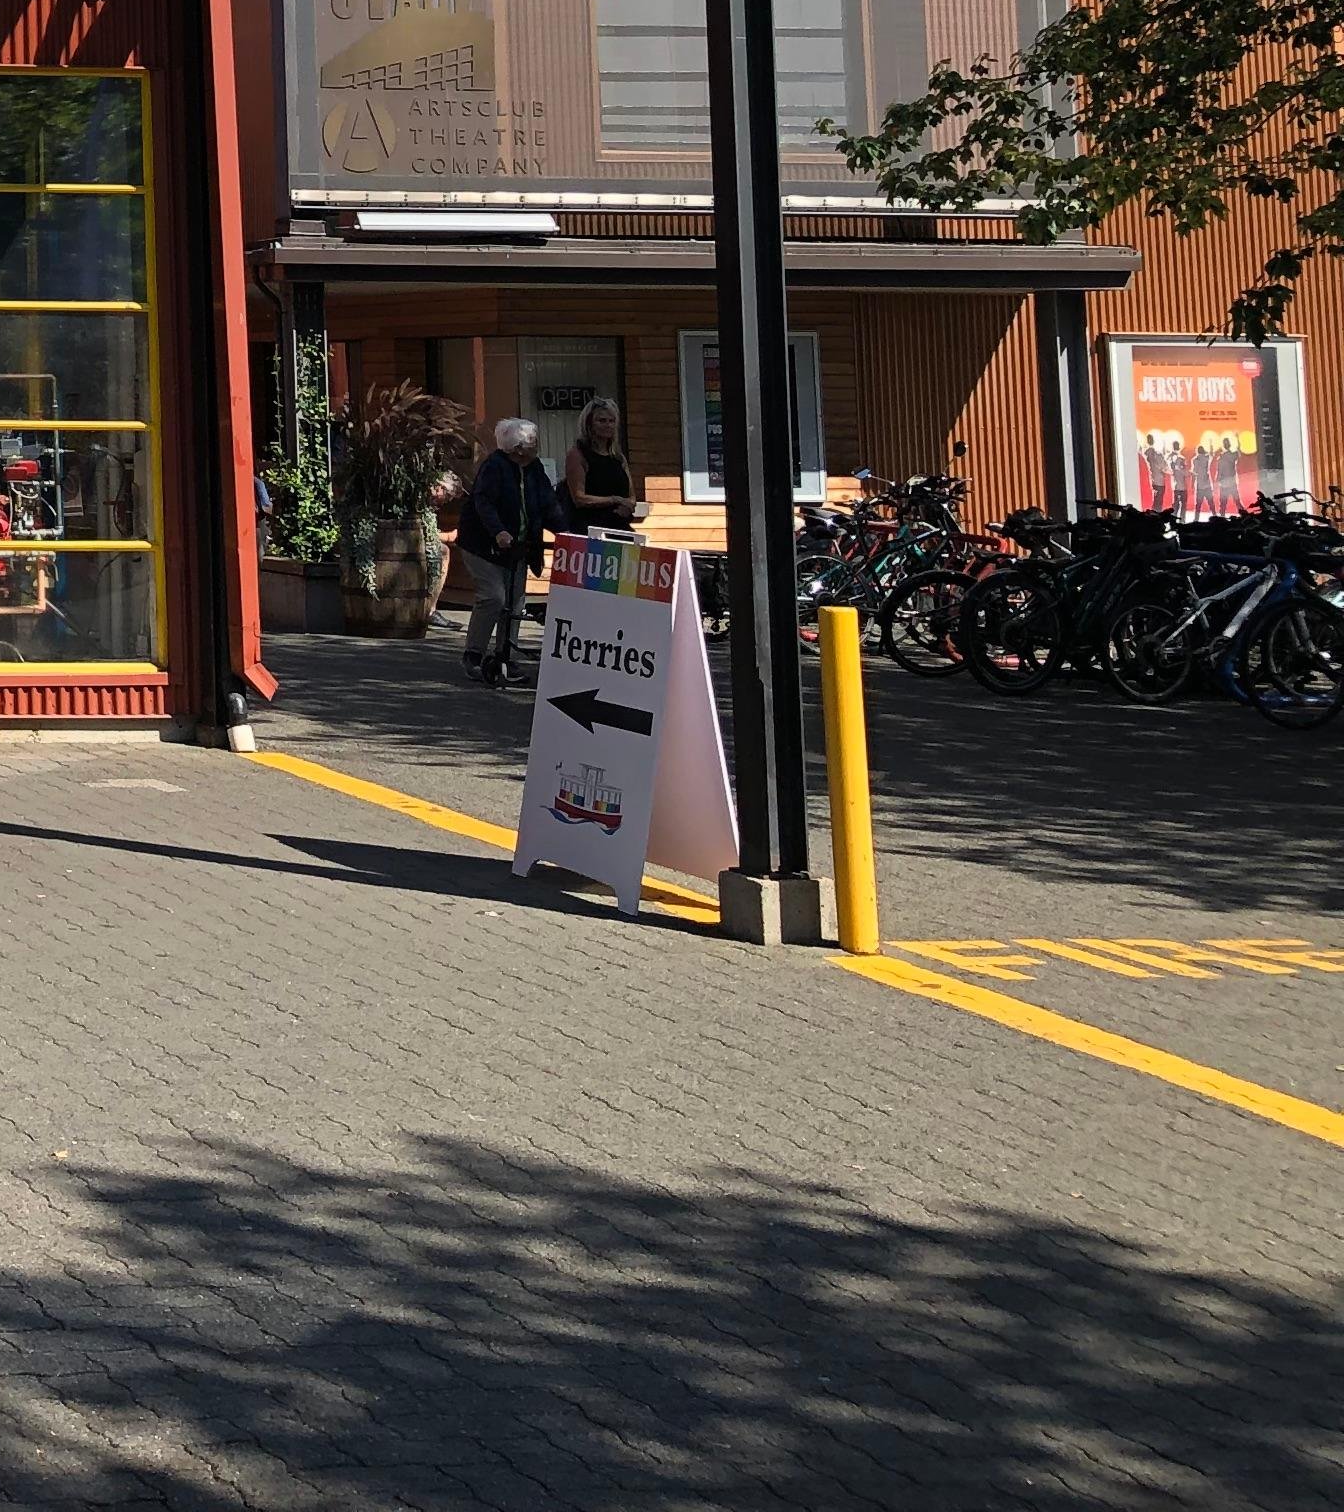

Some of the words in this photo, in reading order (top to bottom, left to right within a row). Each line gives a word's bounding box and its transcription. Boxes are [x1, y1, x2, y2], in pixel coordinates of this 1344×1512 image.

[408, 99, 545, 118] ARTSCLUB
[408, 127, 547, 148] THEATRE
[411, 157, 548, 176] COMPANY
[1138, 376, 1193, 402] JERSEY
[1197, 376, 1236, 402] BOYS
[553, 547, 673, 589] aquabus
[551, 617, 656, 679] Ferries
